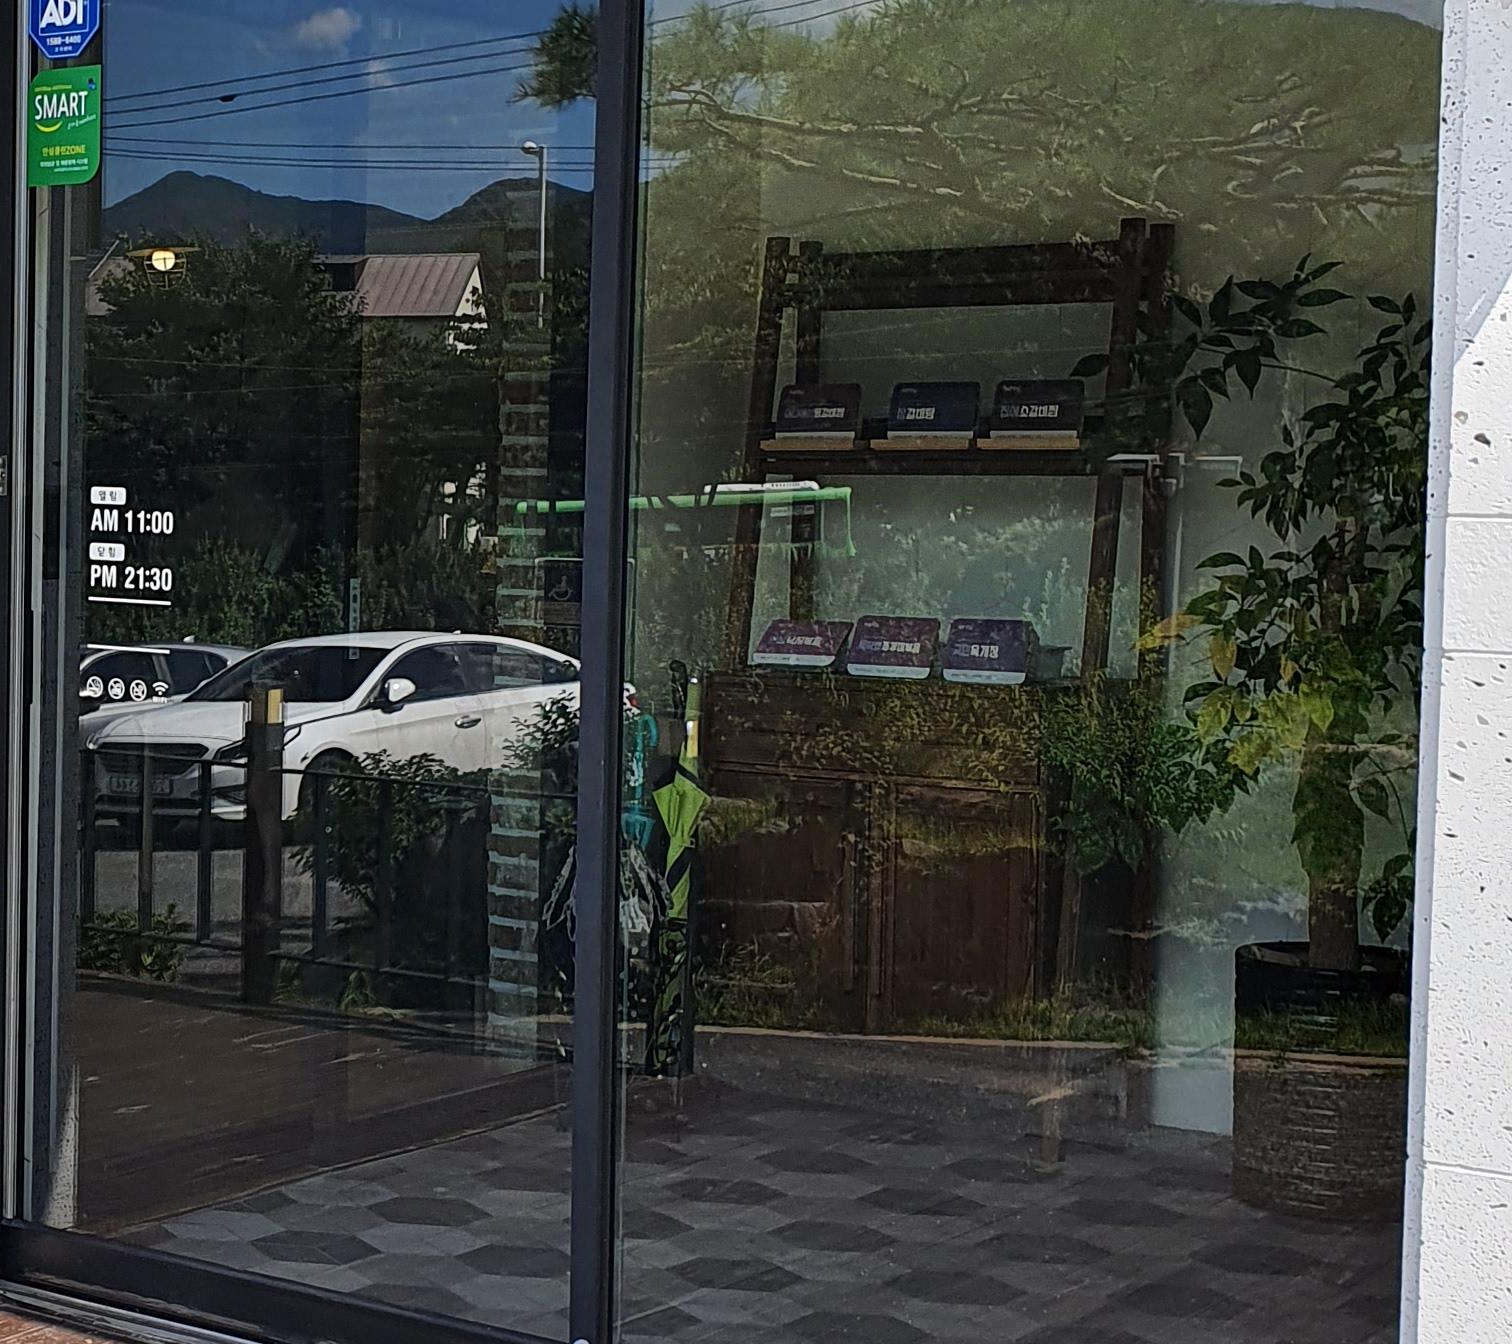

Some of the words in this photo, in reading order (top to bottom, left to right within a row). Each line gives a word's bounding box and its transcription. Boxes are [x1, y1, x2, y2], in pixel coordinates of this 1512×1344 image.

[34, 90, 88, 120] SMART
[90, 508, 119, 532] AM
[124, 509, 174, 535] 11:00
[90, 564, 117, 588] PM
[124, 566, 172, 592] 21:30
